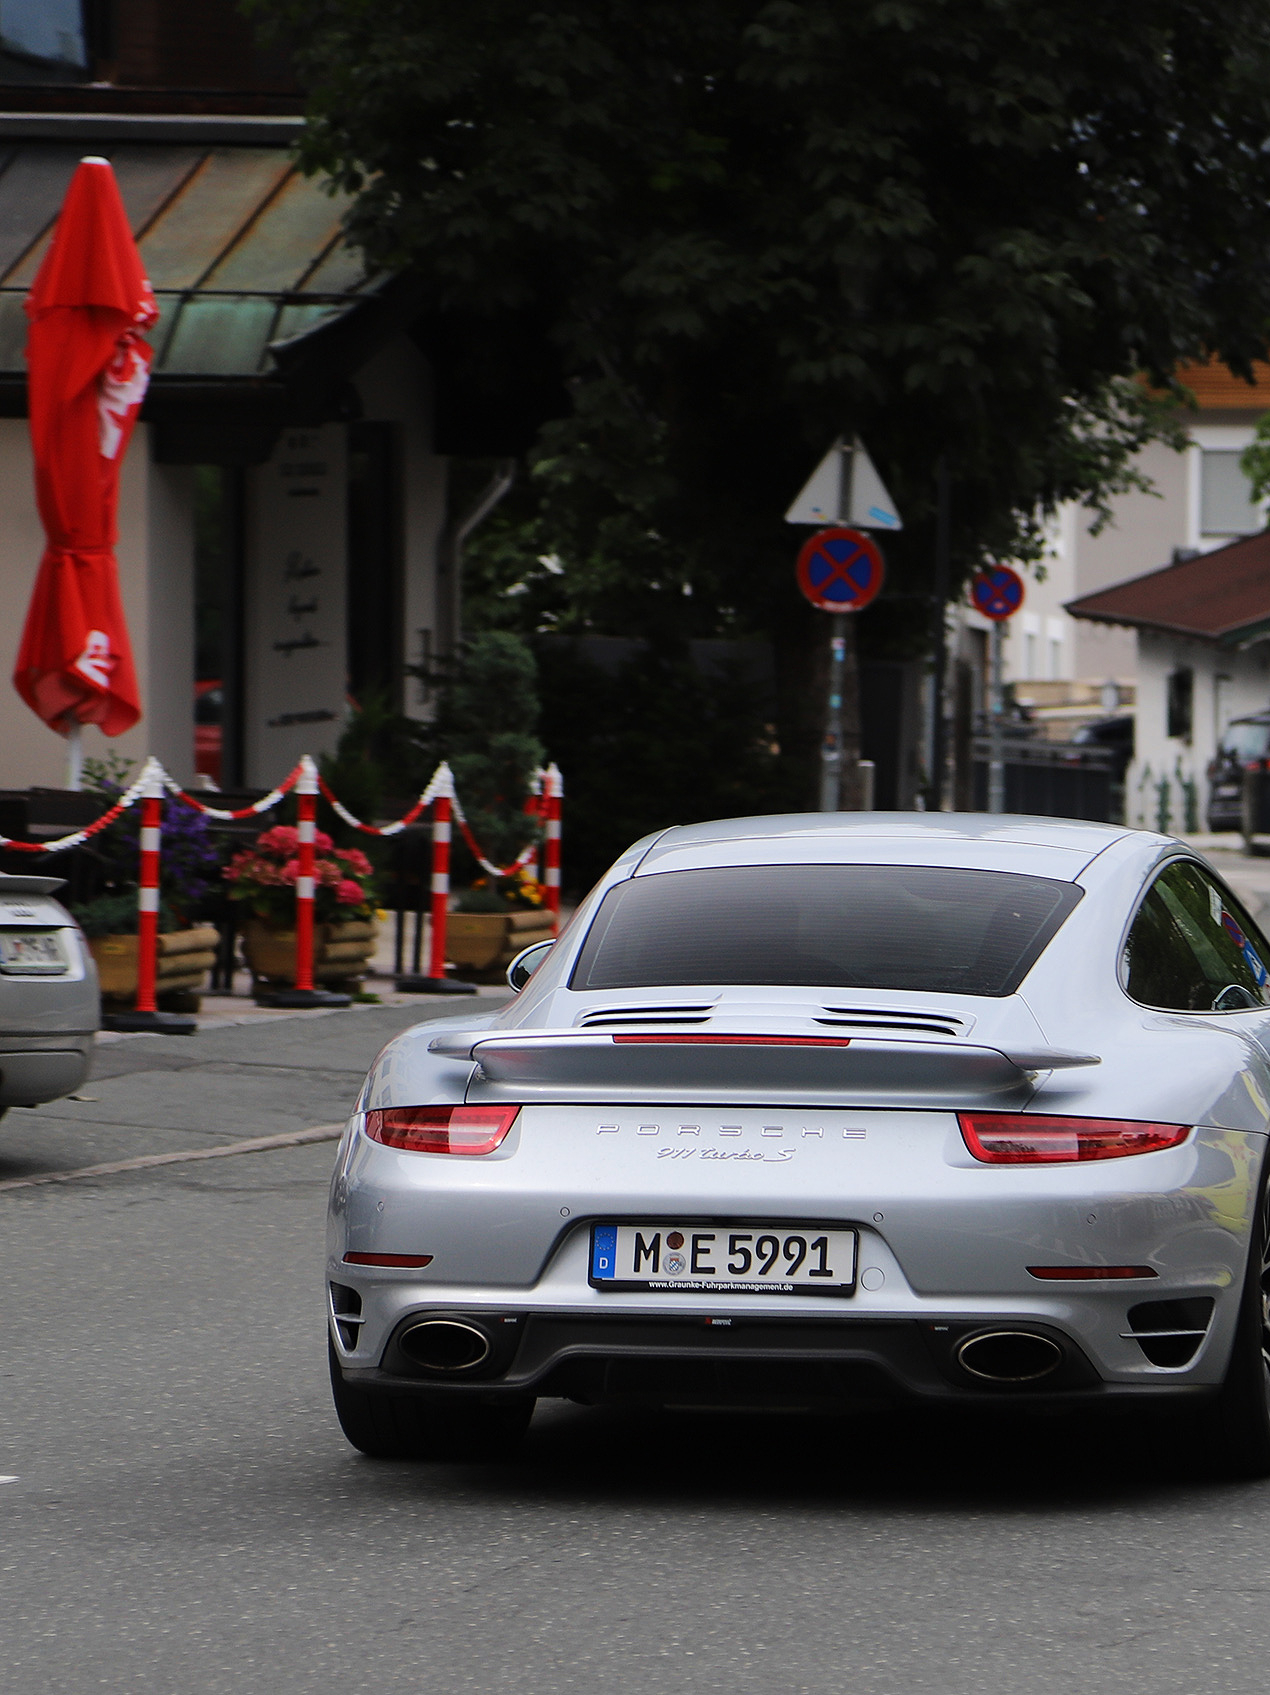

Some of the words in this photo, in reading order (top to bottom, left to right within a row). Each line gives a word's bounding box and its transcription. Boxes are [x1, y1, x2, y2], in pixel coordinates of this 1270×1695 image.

[595, 1123, 868, 1140] PORSCHE
[656, 1146, 699, 1160] 911
[699, 1147, 763, 1160] turbo
[763, 1147, 797, 1162] S
[633, 1232, 661, 1273] M
[690, 1234, 716, 1274] E
[727, 1234, 834, 1277] 5991
[598, 1257, 609, 1270] D
